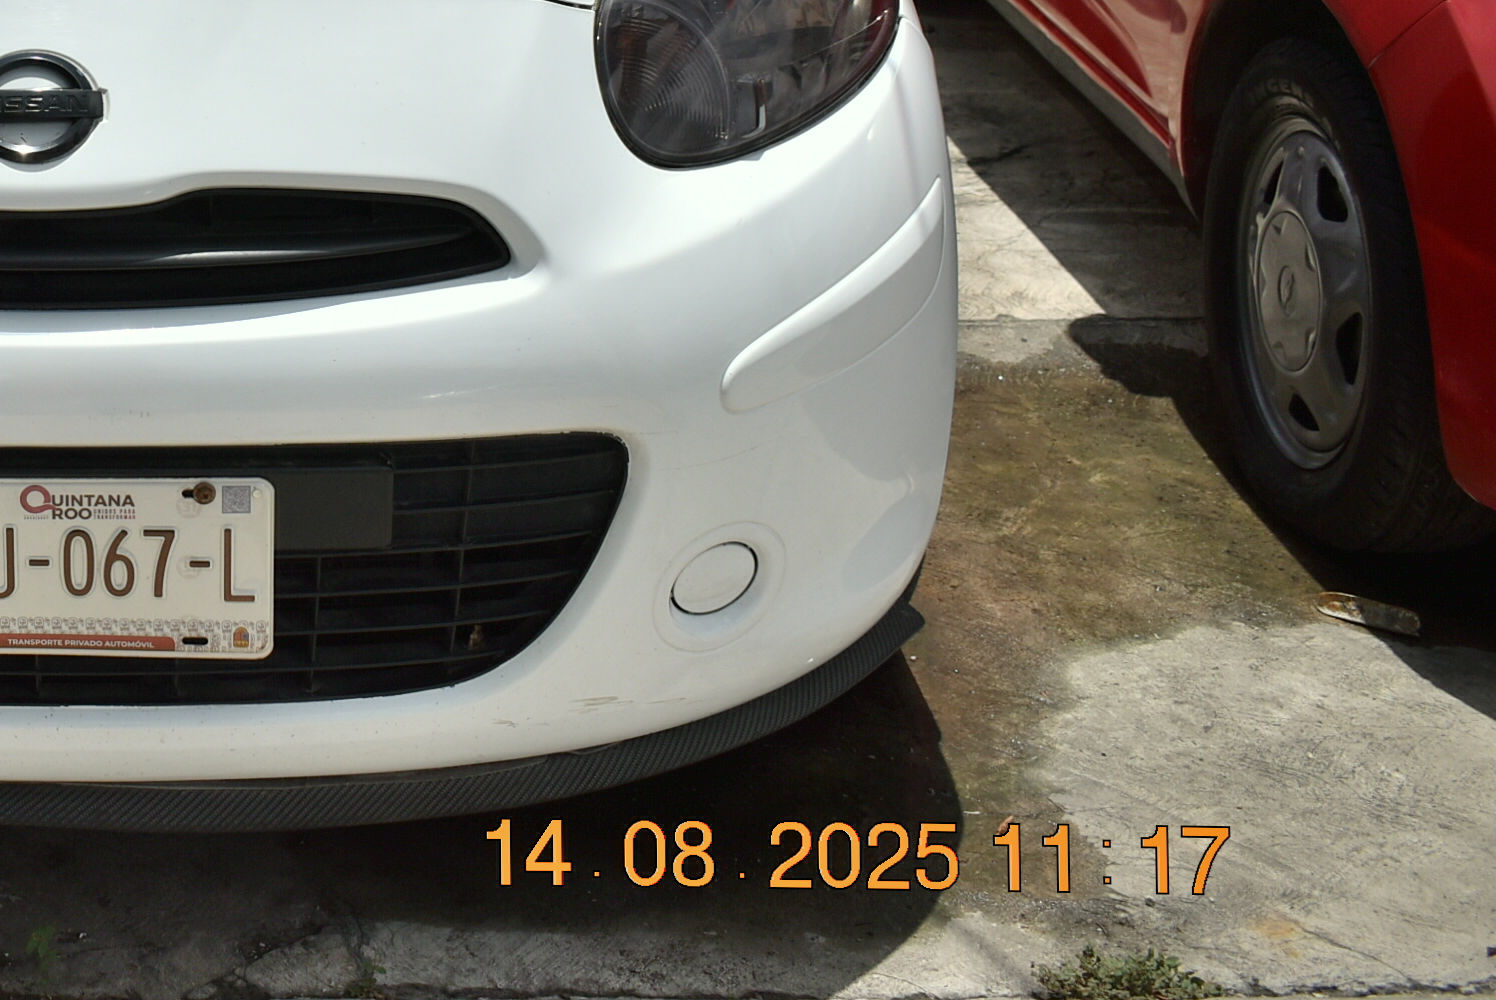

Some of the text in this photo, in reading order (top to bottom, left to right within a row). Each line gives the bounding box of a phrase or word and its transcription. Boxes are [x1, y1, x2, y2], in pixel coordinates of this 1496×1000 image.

[20, 485, 136, 514] QUINTANA
[51, 507, 92, 520] ROO
[7, 638, 154, 649] TRANSPORTE PRIVADO AUTOMÓVIL
